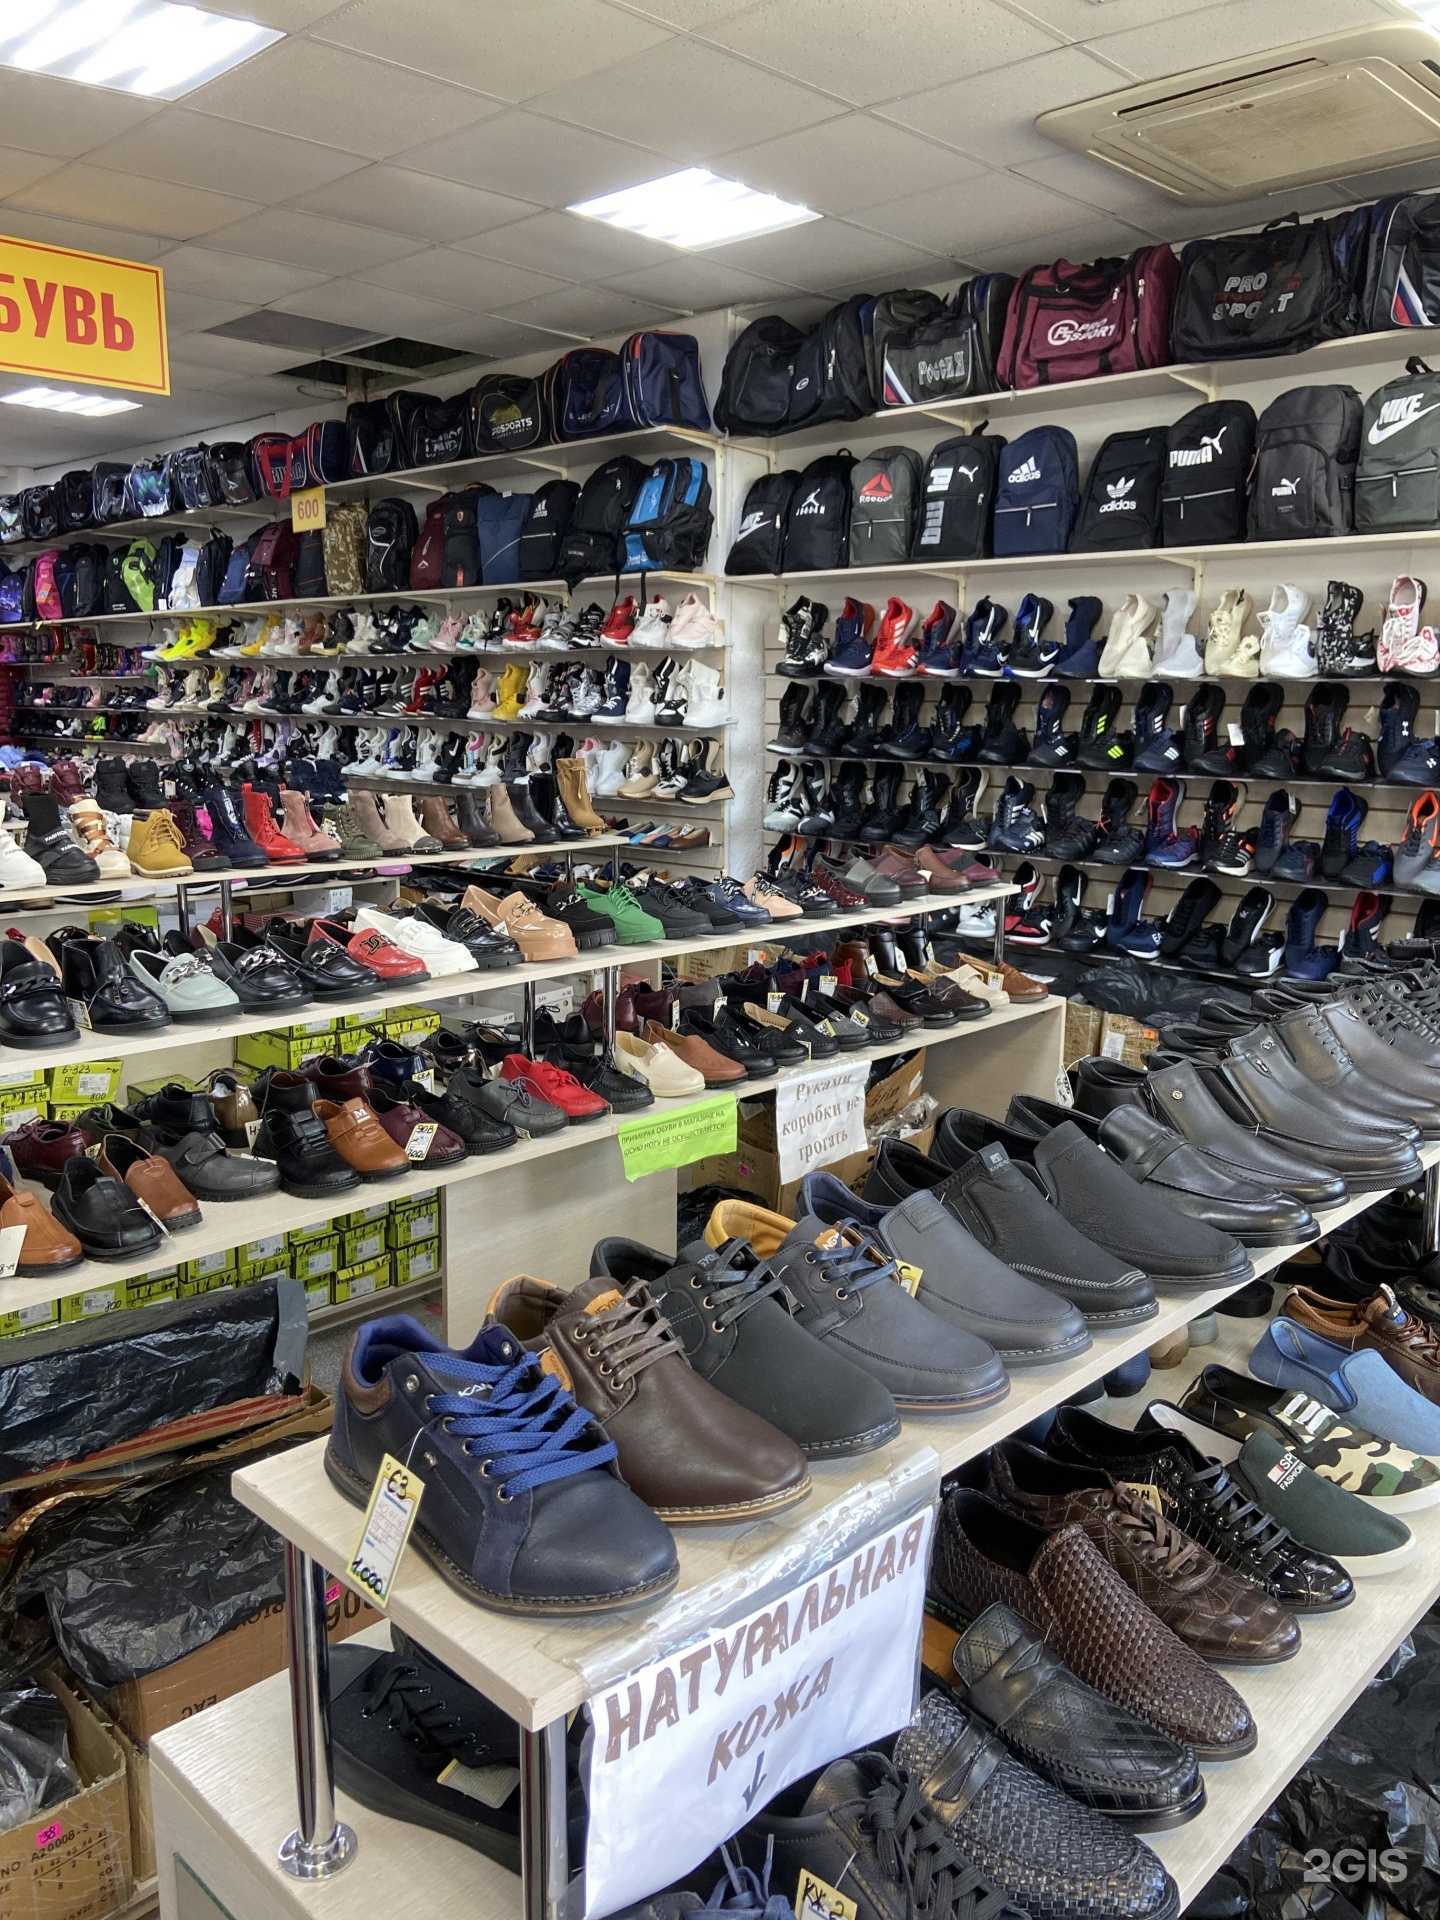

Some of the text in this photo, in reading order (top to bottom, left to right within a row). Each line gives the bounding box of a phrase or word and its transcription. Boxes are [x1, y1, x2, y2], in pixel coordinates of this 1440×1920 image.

[1223, 272, 1268, 293] PRO
[1379, 393, 1424, 425] NIKE
[1169, 445, 1213, 469] PUMA
[1008, 469, 1041, 484] adidas
[296, 500, 319, 521] 600
[1099, 499, 1137, 513] adidas
[796, 1074, 852, 1101] Руками
[782, 1103, 841, 1137] коробки
[798, 1129, 849, 1163] трогать
[604, 1515, 926, 1764] НАТУРАЛЬНАЯ
[706, 1656, 835, 1787] КОЖА
